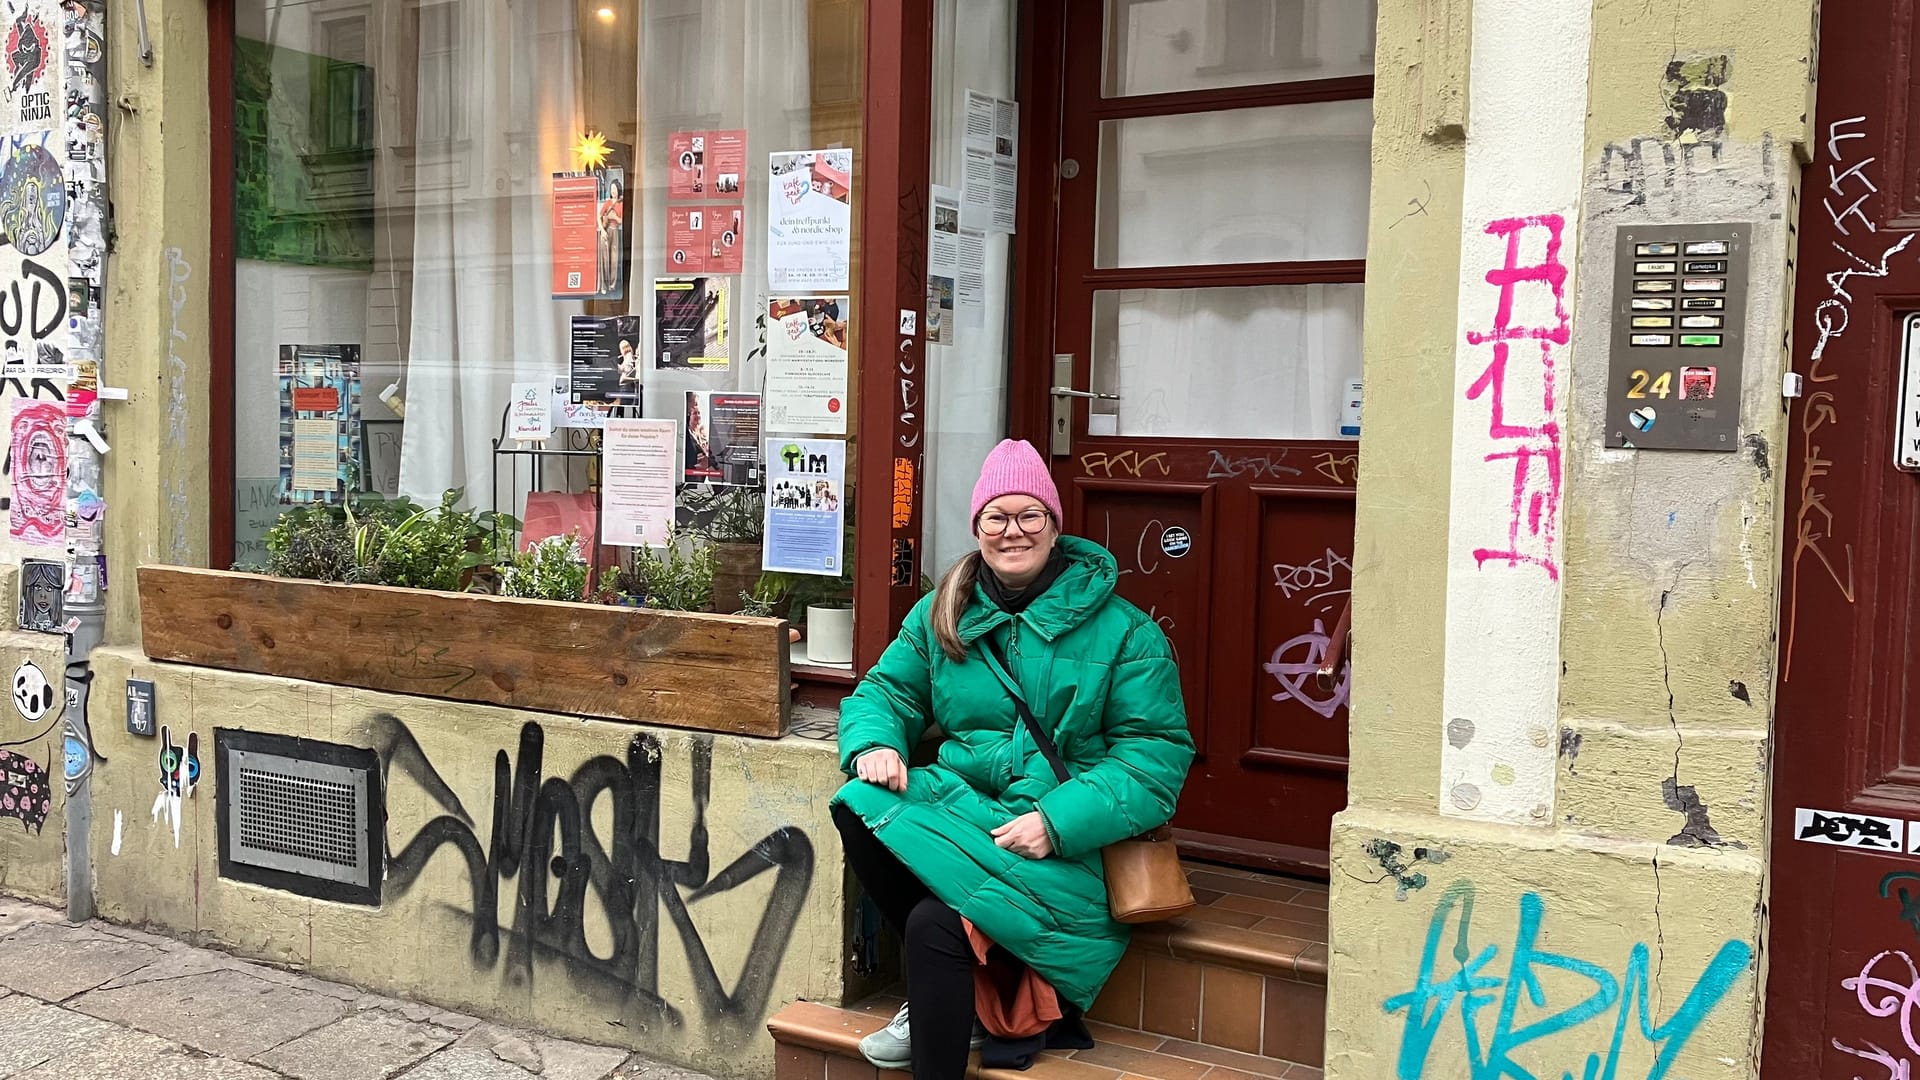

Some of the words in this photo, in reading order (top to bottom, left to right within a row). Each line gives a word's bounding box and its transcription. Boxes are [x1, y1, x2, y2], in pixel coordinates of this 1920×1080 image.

[21, 92, 50, 108] OPTIC
[21, 105, 51, 122] NINJA
[800, 225, 824, 234] nordic
[825, 225, 843, 235] shop
[1627, 369, 1672, 400] 24
[1273, 547, 1353, 599] ROSA
